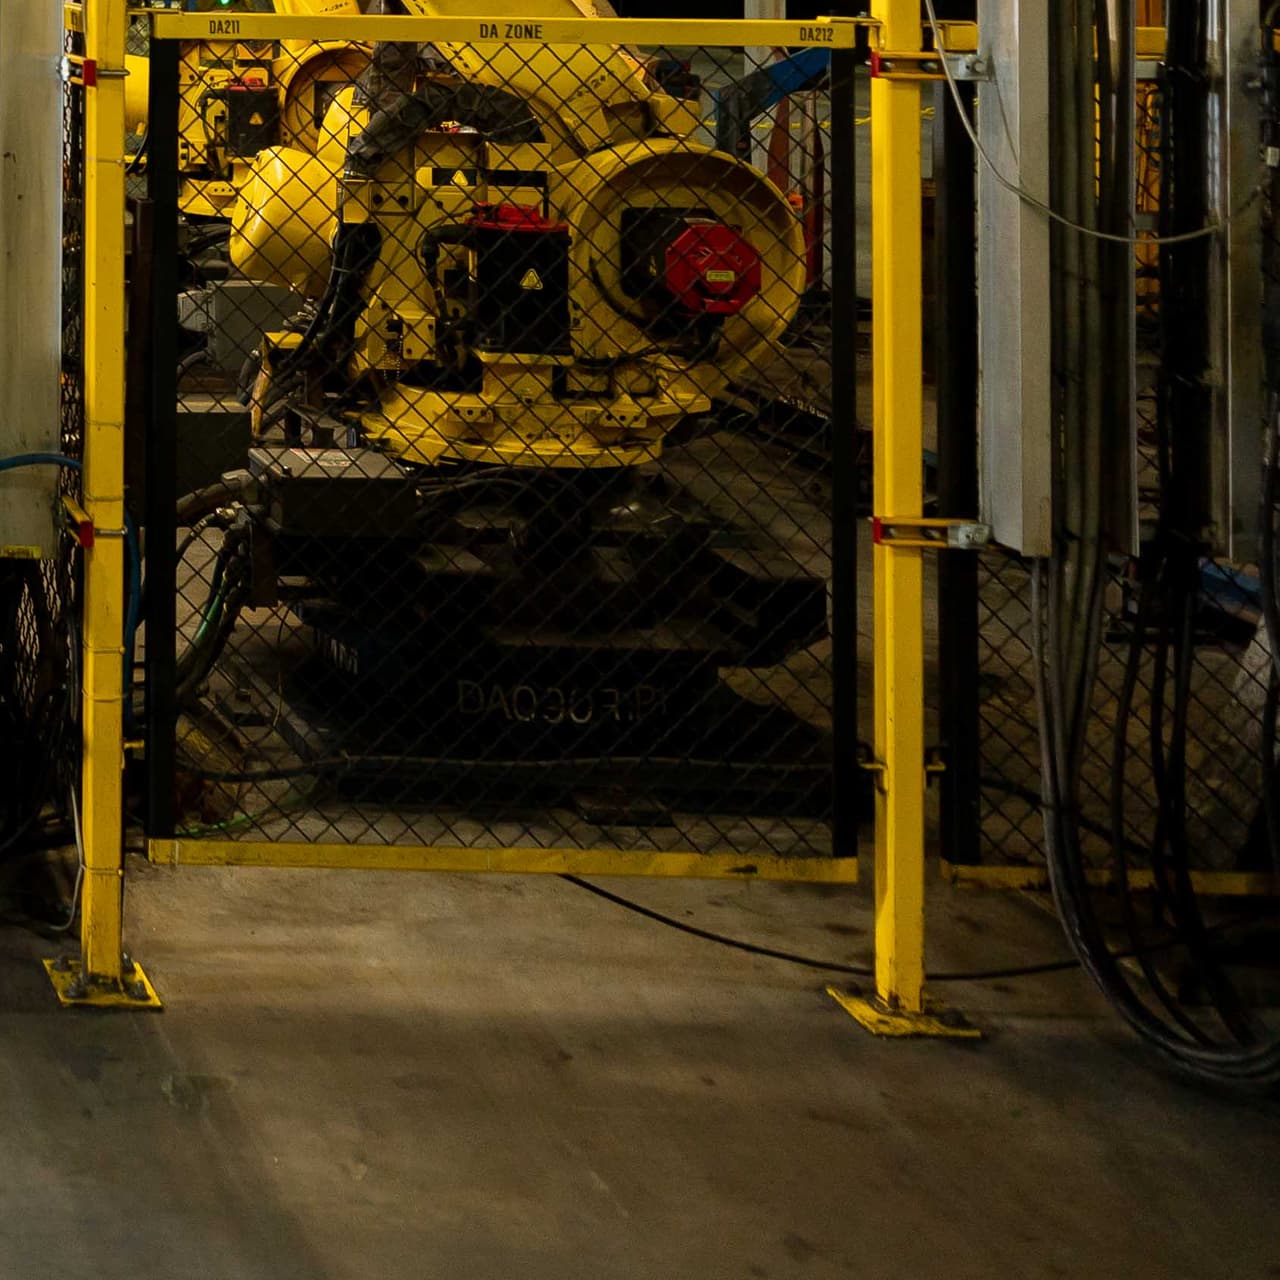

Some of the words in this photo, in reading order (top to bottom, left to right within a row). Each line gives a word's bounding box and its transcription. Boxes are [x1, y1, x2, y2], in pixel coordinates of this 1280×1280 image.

[209, 20, 240, 34] DA211
[479, 23, 498, 39] DA
[505, 23, 543, 39] ZONE
[800, 27, 834, 42] DA212
